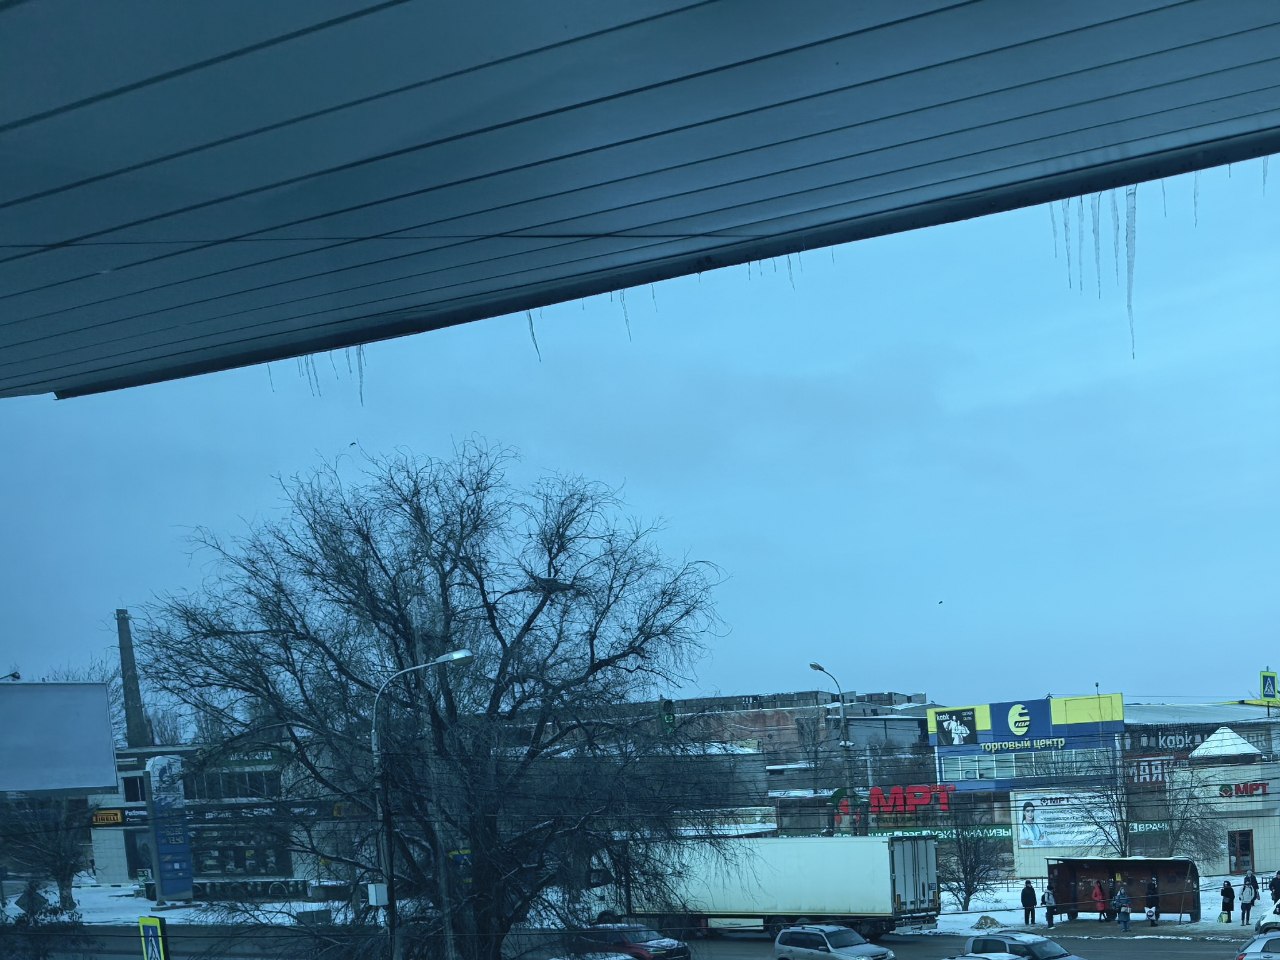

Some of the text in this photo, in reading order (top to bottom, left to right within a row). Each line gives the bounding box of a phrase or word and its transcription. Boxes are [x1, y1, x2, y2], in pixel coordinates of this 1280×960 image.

[980, 737, 1066, 753] торговый центр
[1234, 783, 1270, 796] МРТ
[869, 785, 956, 815] МРТ
